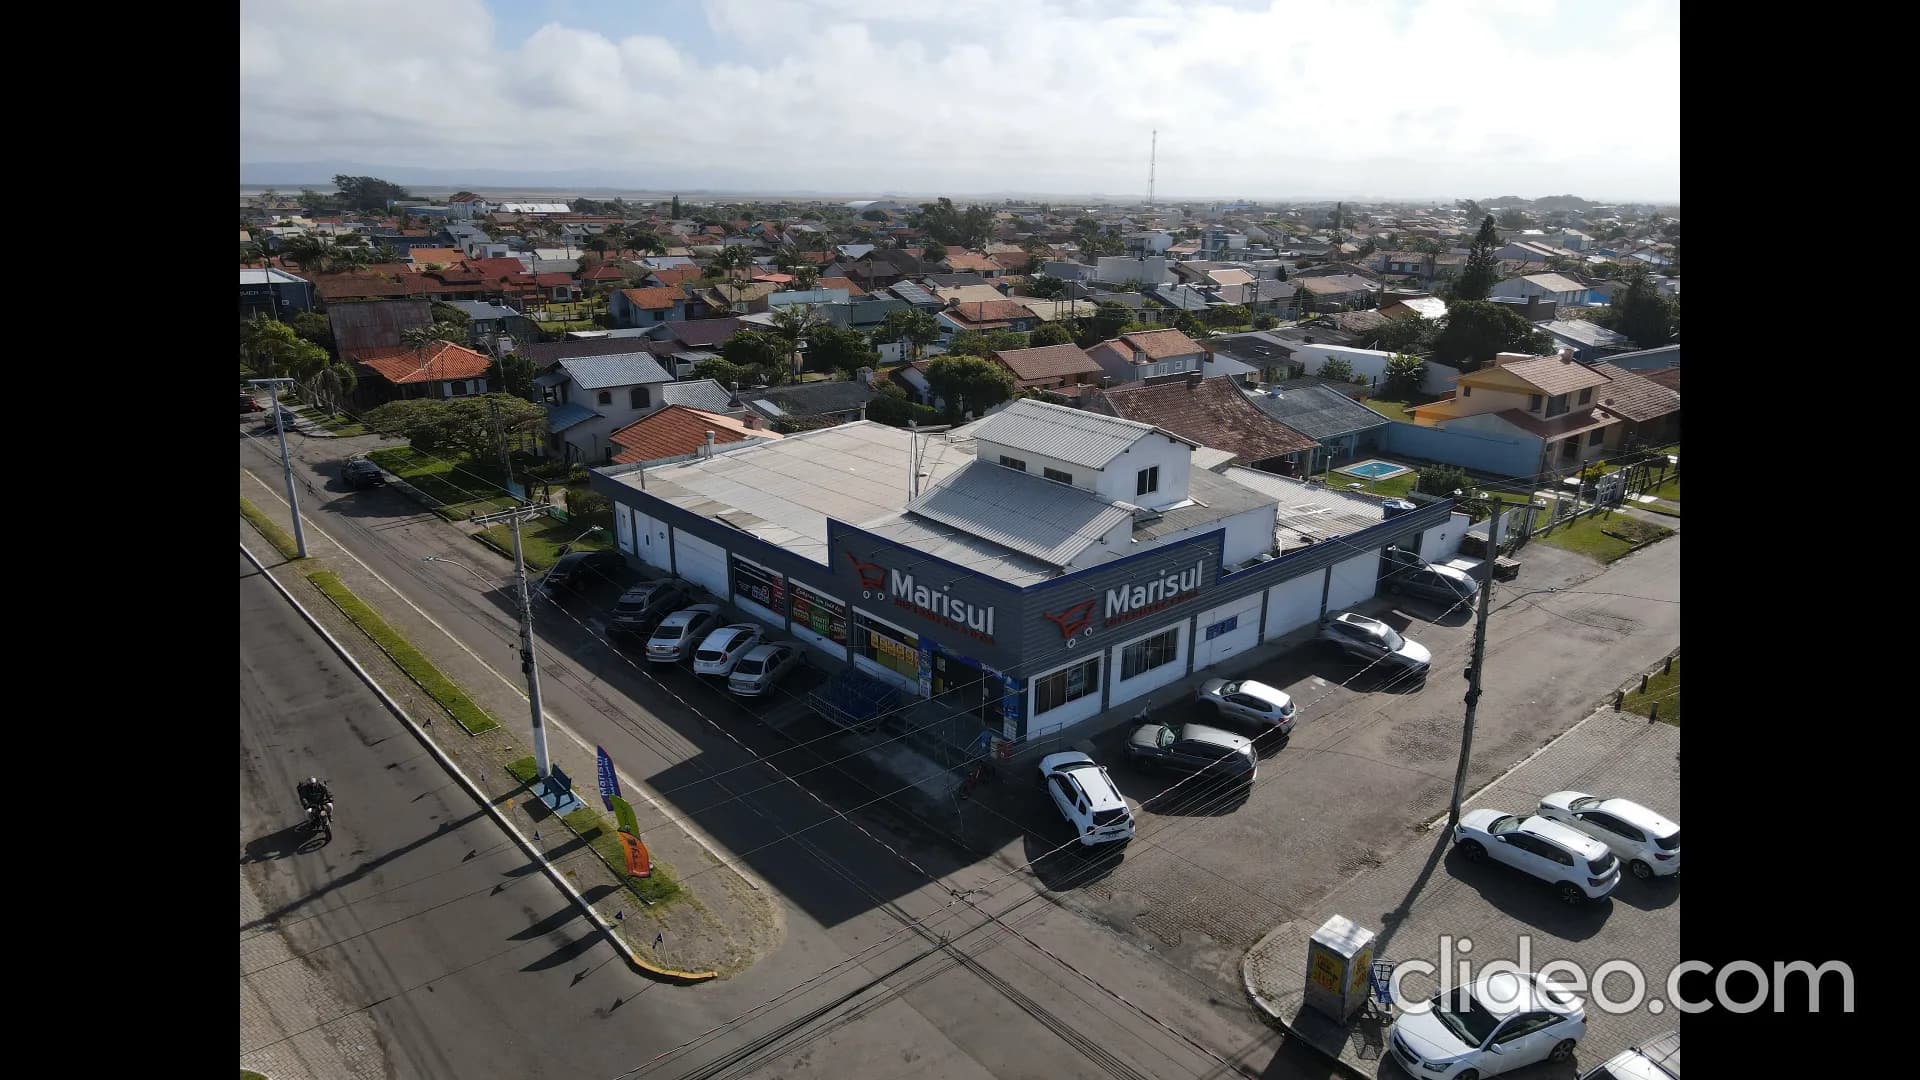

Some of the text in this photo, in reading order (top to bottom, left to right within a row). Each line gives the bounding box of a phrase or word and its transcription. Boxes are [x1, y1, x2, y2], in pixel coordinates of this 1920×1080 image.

[891, 568, 995, 636] Marisul
[1104, 560, 1203, 618] Marisul
[596, 755, 609, 797] Marisul
